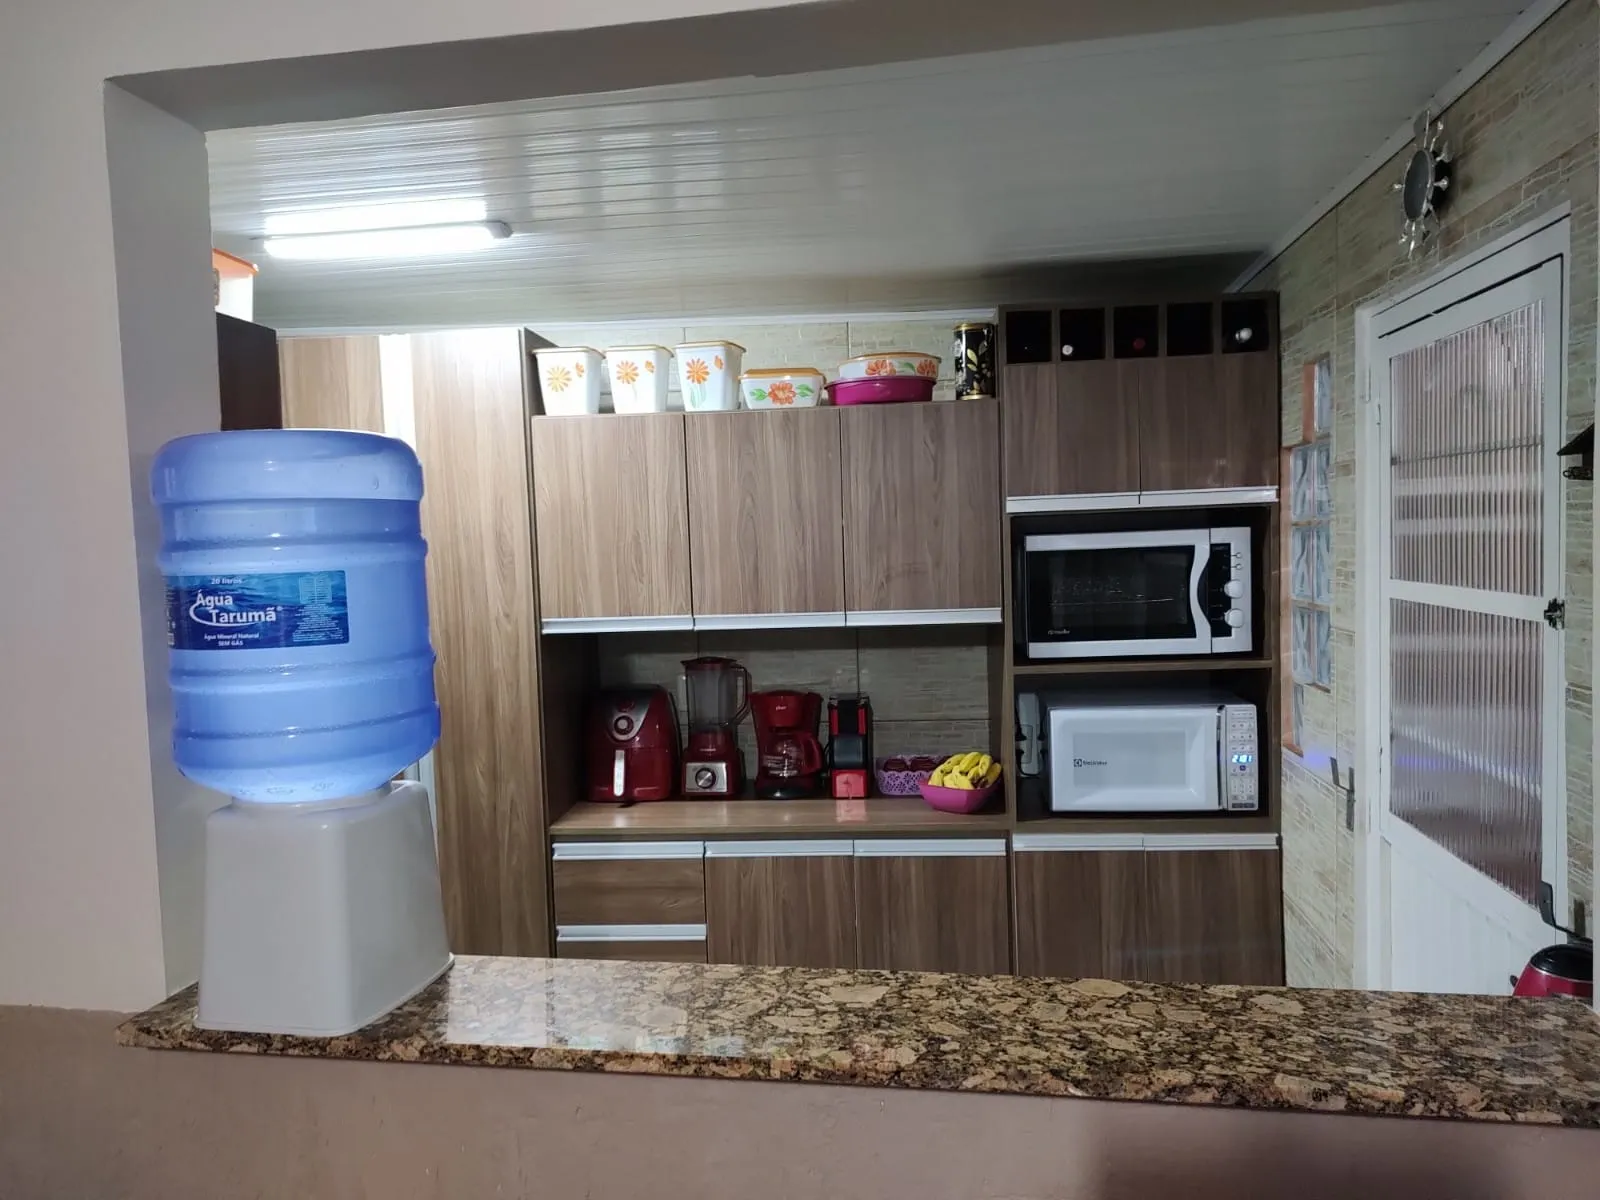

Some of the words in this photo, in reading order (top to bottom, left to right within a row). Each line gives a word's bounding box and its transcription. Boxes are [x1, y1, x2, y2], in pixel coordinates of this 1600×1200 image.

[210, 577, 220, 585] 20
[196, 589, 233, 609] Água
[209, 606, 276, 624] Tarumã
